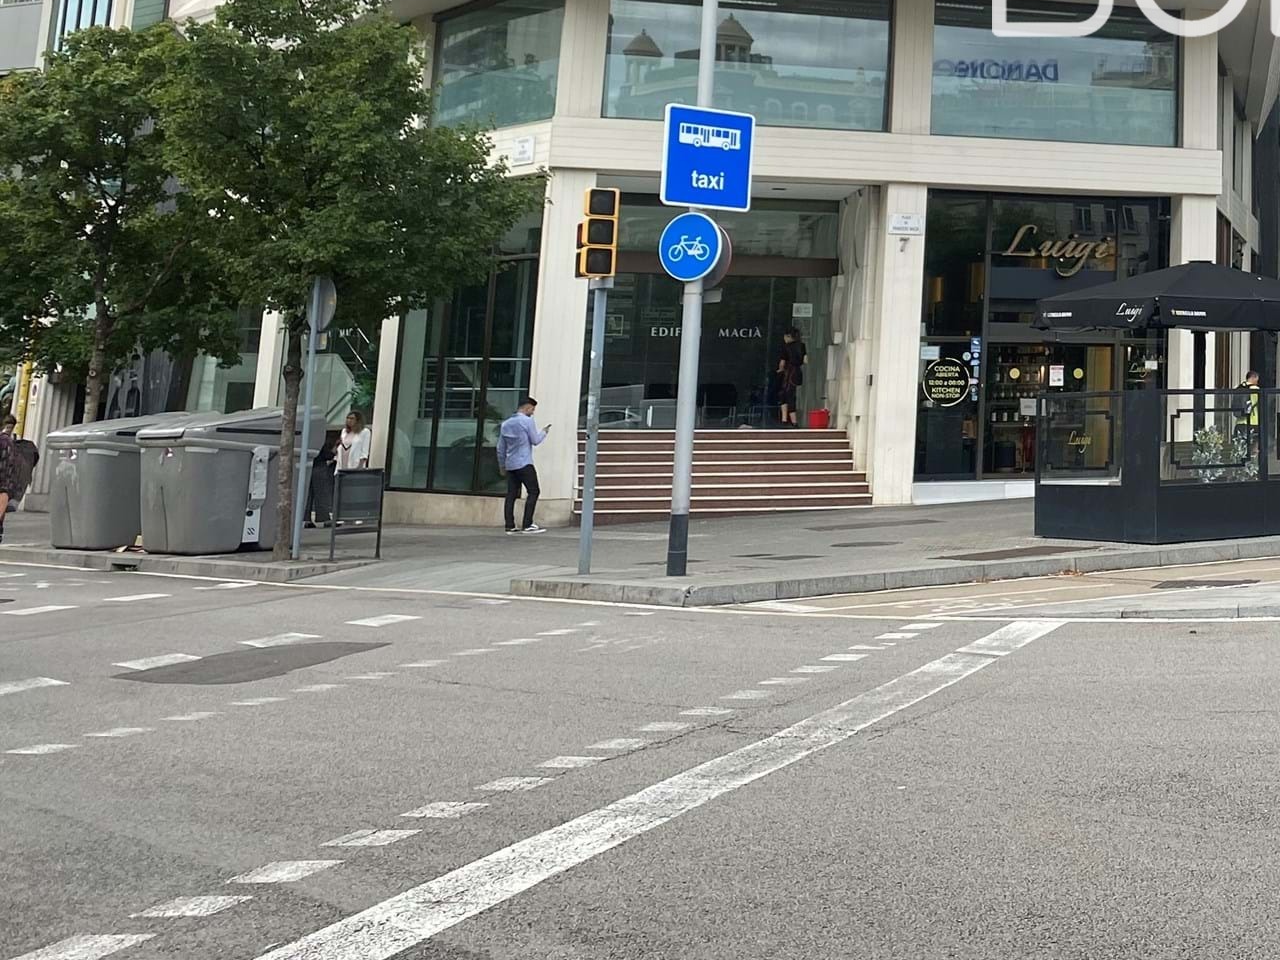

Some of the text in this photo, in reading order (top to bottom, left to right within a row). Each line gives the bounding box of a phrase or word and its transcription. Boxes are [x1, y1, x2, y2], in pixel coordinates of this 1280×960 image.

[690, 169, 725, 191] taxi
[899, 237, 910, 253] 7
[1001, 224, 1112, 277] Luigi
[1115, 302, 1144, 322] Luigi
[718, 326, 762, 338] MACIÀ
[1068, 430, 1092, 453] Luigi
